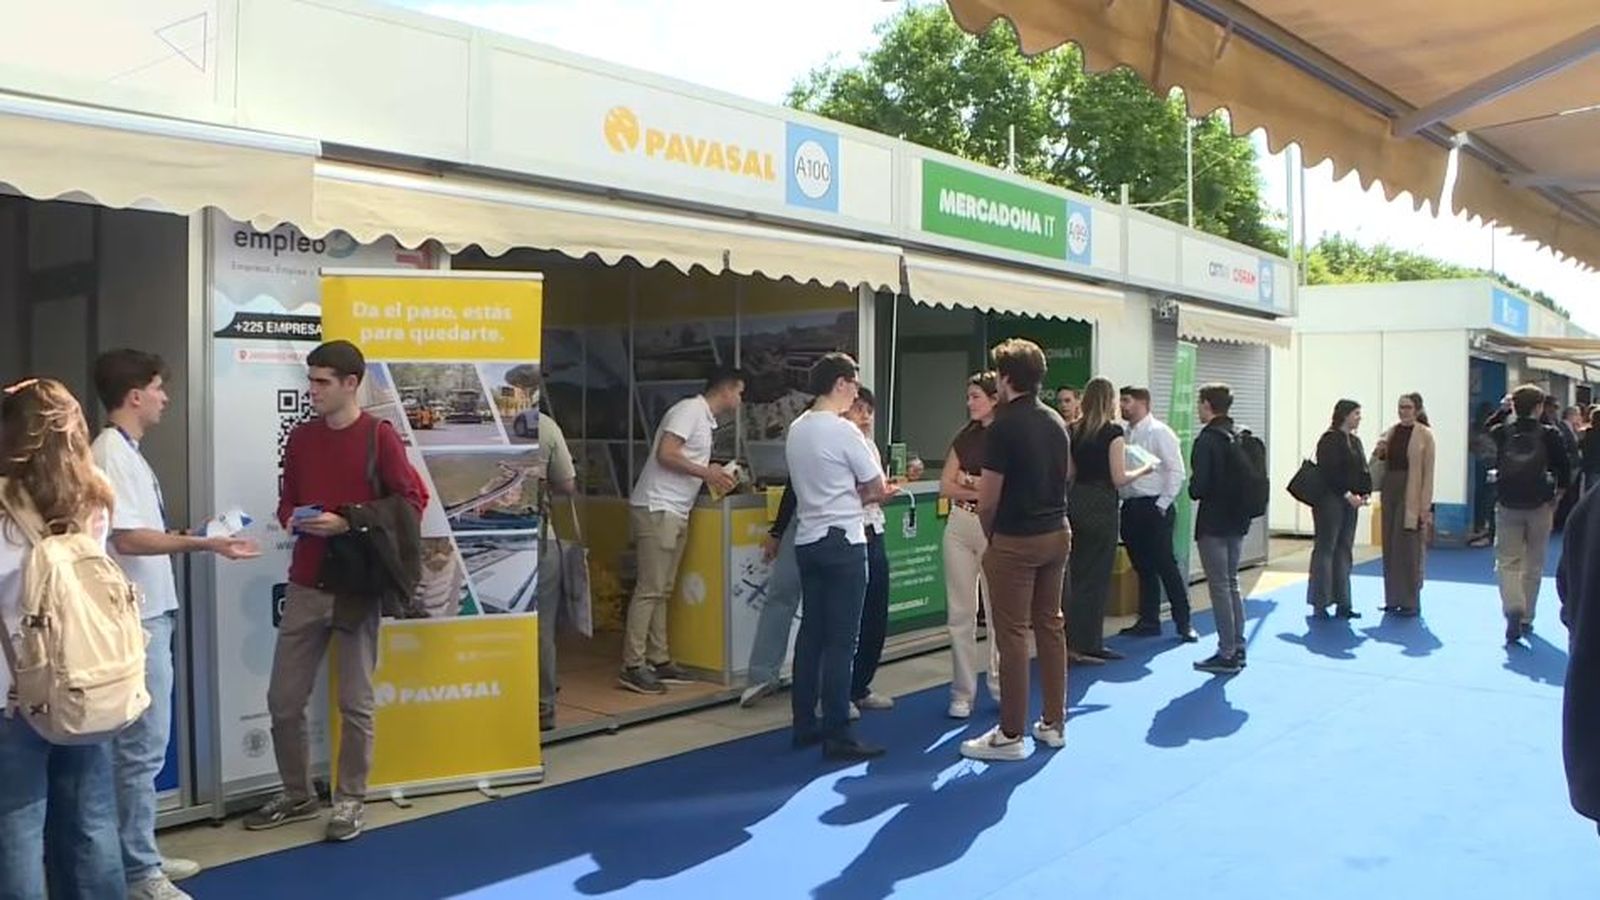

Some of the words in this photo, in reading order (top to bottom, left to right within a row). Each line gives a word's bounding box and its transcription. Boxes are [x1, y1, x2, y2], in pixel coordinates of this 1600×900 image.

[645, 128, 776, 181] PAVASAL
[796, 156, 830, 182] A100
[939, 188, 1041, 236] MERCADONA
[1044, 214, 1056, 237] IT
[234, 230, 326, 256] empleo
[352, 302, 380, 318] Da
[384, 302, 402, 318] el
[463, 303, 513, 321] estás
[234, 321, 264, 333] +225
[361, 327, 405, 344] para
[410, 324, 505, 345] quedarte.
[400, 681, 502, 705] PAVASAL
